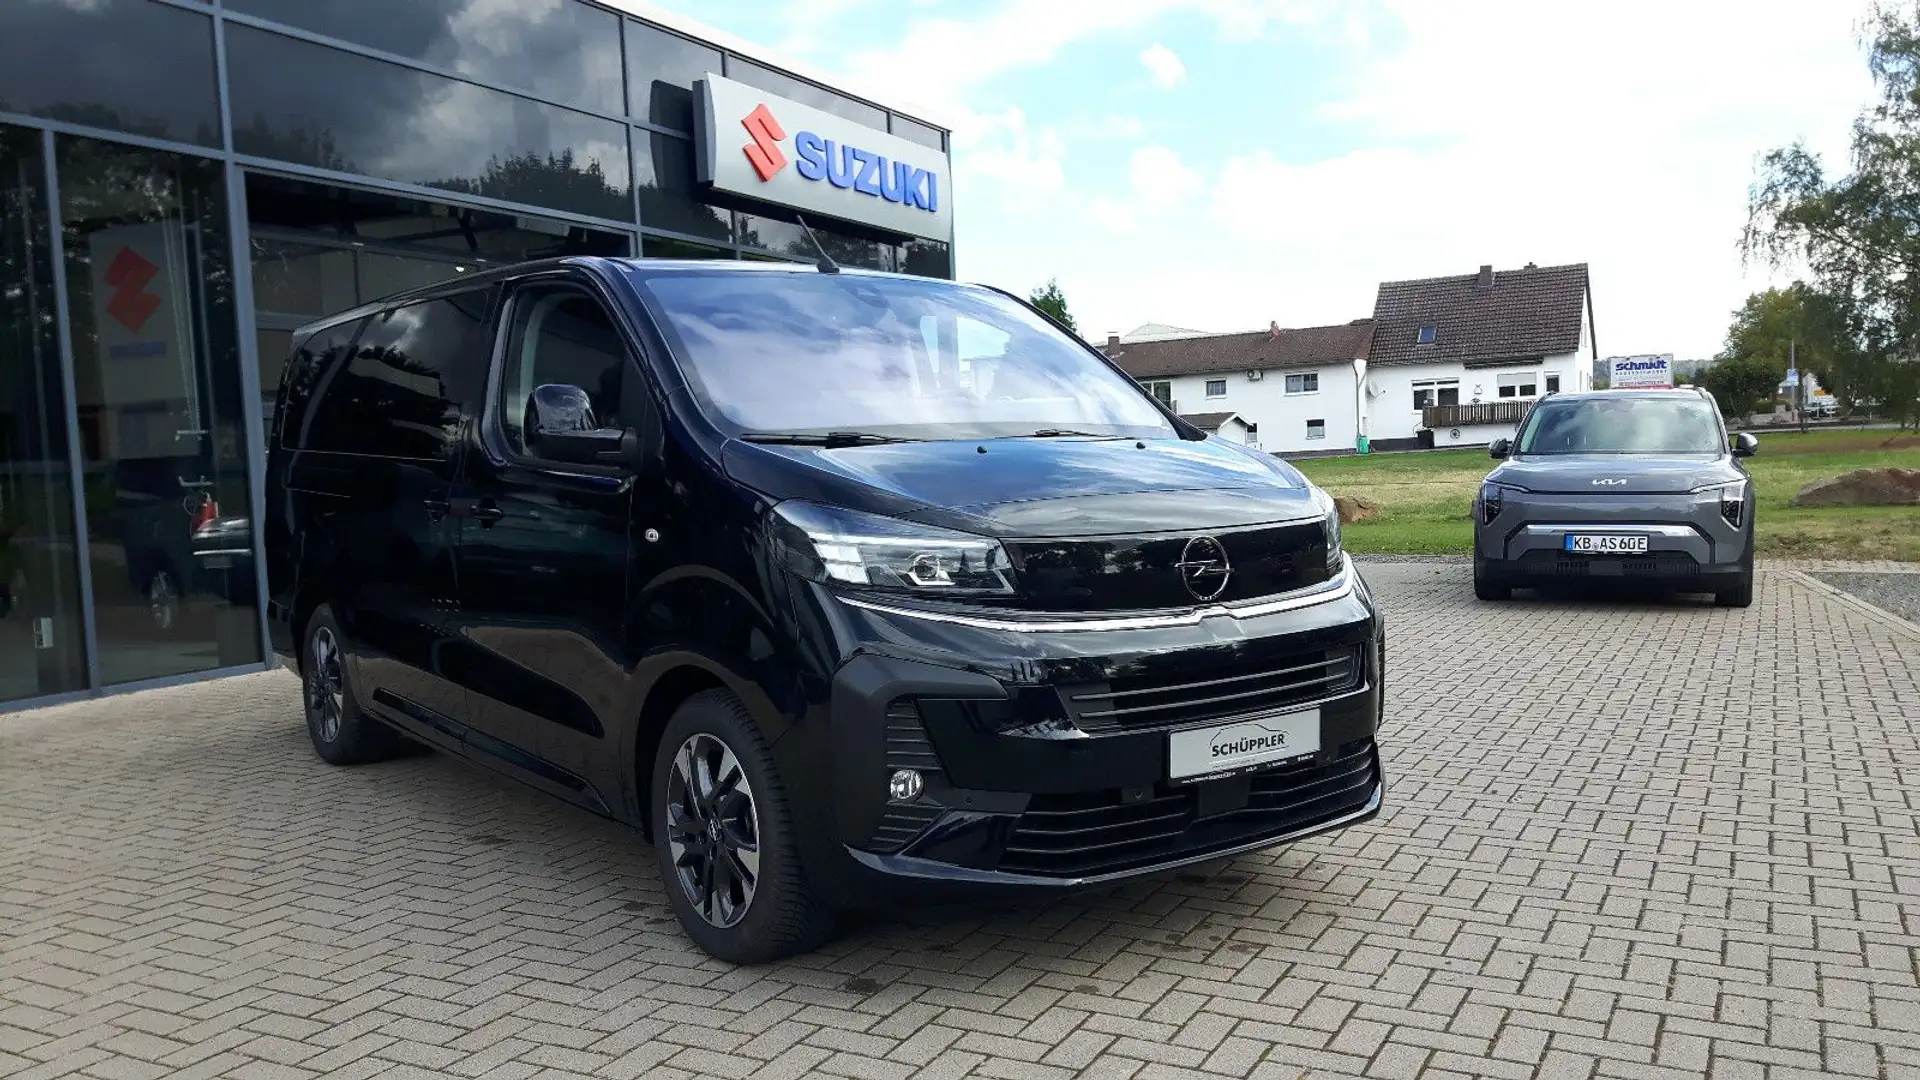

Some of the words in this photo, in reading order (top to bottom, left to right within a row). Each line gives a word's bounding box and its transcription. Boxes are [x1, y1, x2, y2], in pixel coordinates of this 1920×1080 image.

[795, 131, 938, 213] SUZUKI
[1615, 359, 1668, 371] schmidt
[1574, 537, 1591, 550] KB
[1211, 733, 1286, 757] SCHÜPPLER
